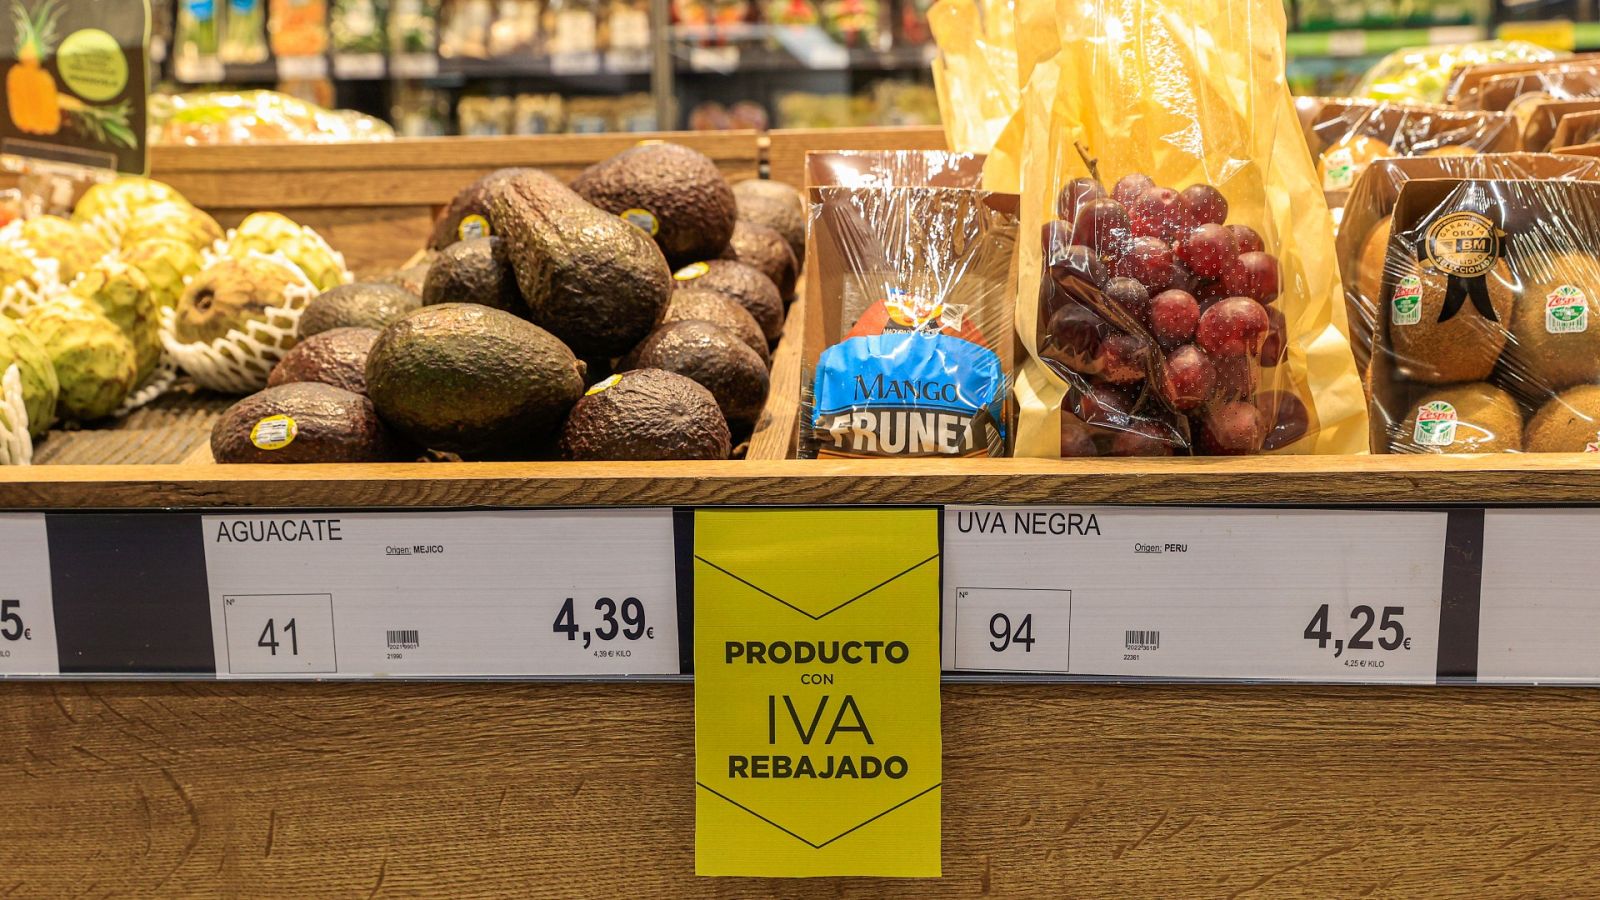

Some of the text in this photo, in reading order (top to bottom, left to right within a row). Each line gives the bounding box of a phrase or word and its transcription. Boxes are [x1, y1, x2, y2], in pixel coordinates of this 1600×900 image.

[1461, 239, 1486, 250] BM
[216, 519, 343, 543] AGUACATE
[957, 511, 1101, 536] UVA NEGRA
[385, 545, 444, 556] Origen: MEJICO
[1134, 542, 1188, 553] Origen: PERU
[257, 617, 298, 656] 41
[989, 612, 1036, 653] 94
[615, 650, 632, 658] KILO
[725, 640, 910, 665] PRODUCTO
[1367, 660, 1385, 668] KILO
[800, 673, 834, 685] CON
[768, 694, 875, 745] IVA
[728, 755, 909, 780] REBAJADO
